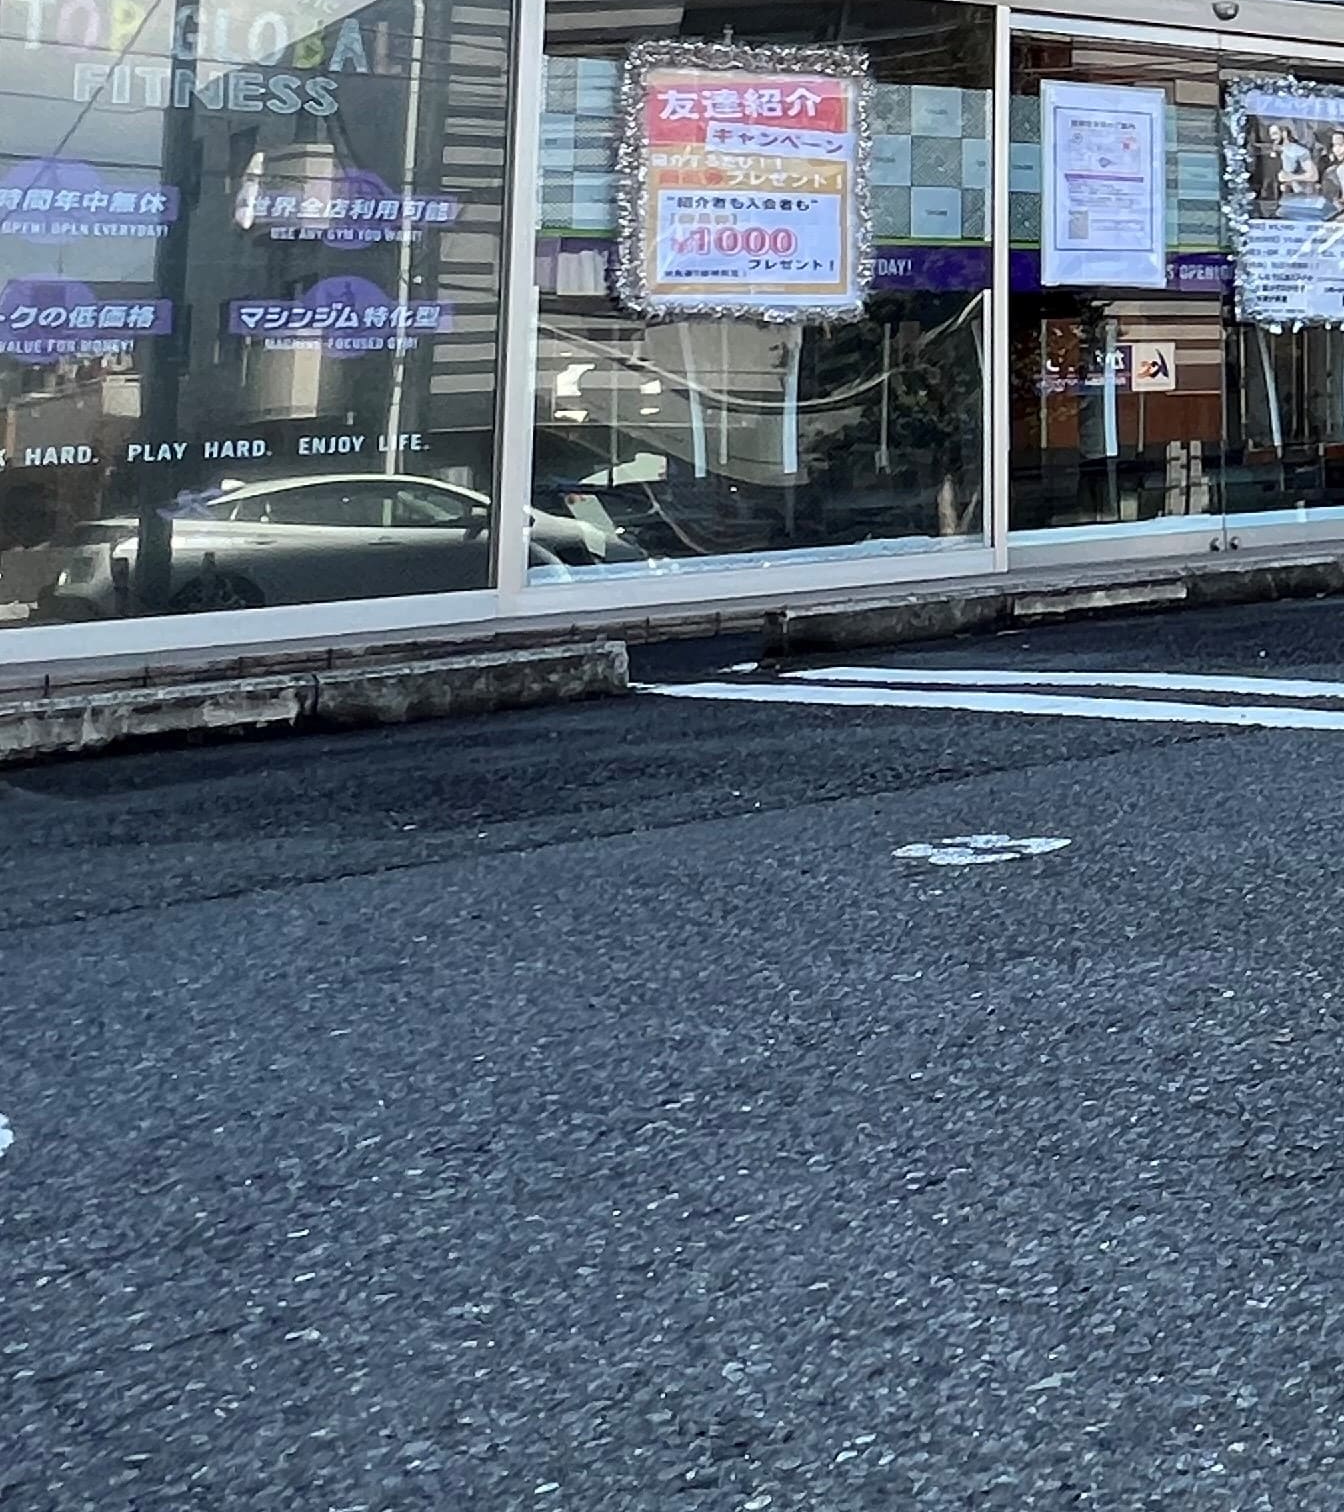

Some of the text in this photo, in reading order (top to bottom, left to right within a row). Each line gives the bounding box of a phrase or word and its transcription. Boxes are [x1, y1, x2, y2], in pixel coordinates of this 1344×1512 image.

[171, 2, 404, 76] GLOBAL
[72, 62, 340, 117] FITNESS
[656, 88, 823, 120] 友達紹介
[239, 301, 441, 329] マシンジム特化型
[24, 445, 100, 466] HARD.
[127, 442, 189, 462] PLAY
[203, 440, 273, 459] HARD.
[298, 436, 366, 455] ENJOY
